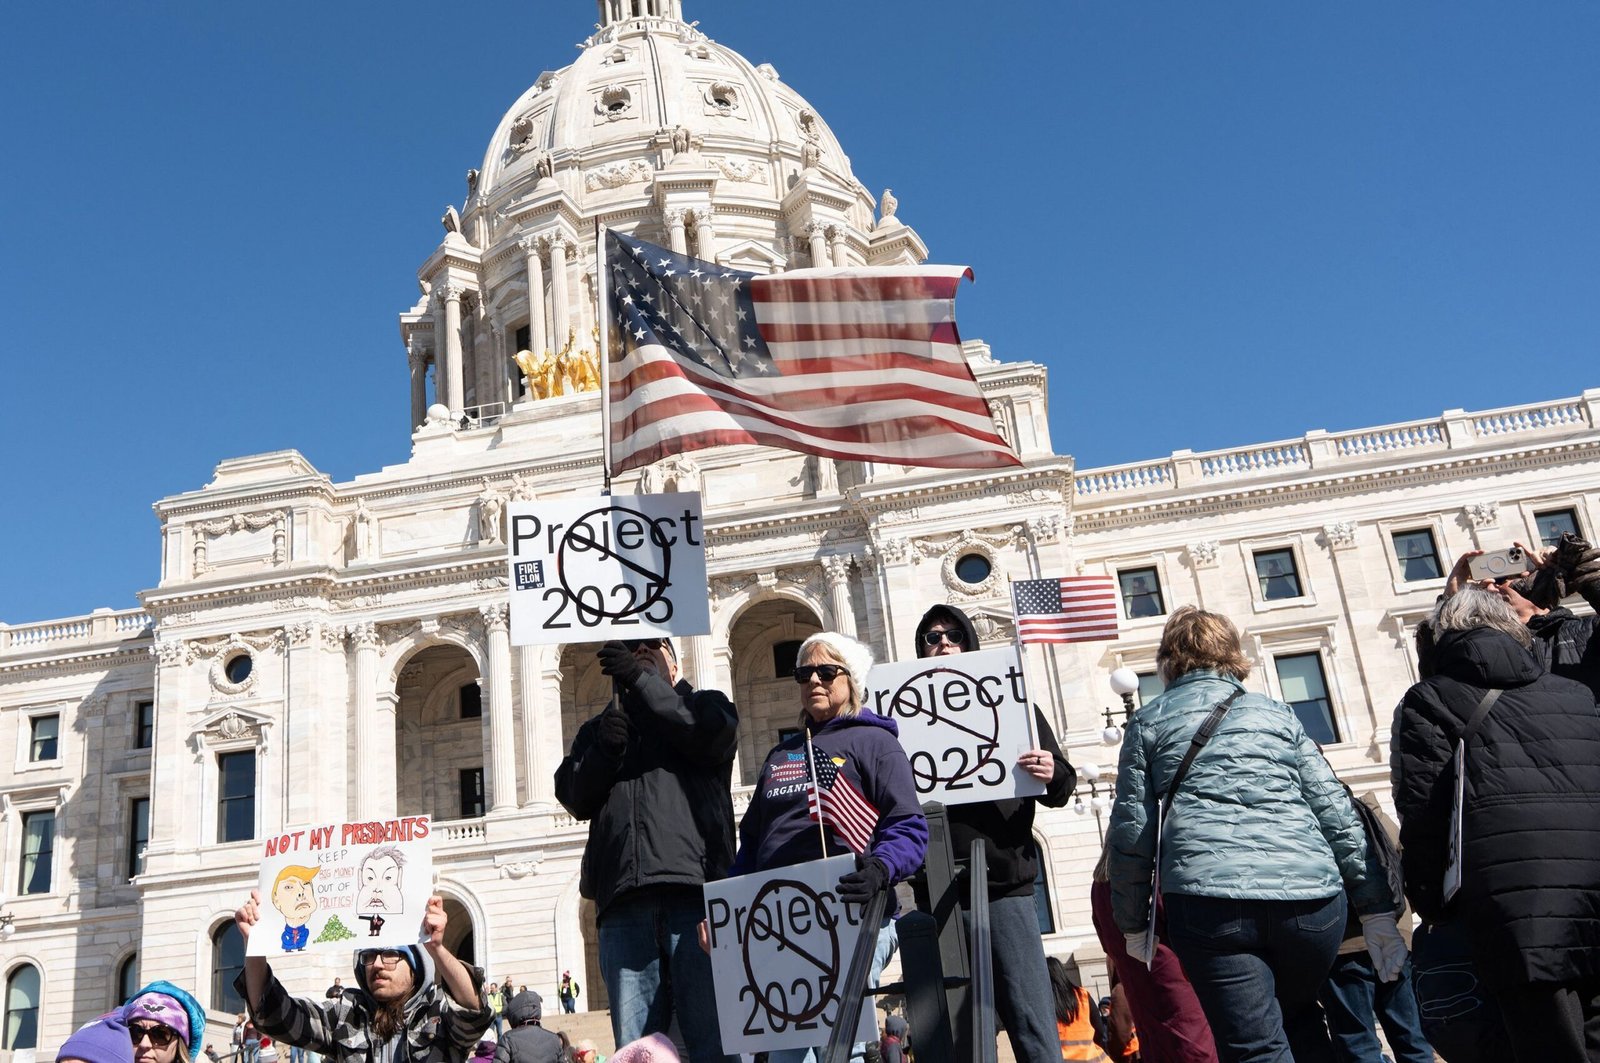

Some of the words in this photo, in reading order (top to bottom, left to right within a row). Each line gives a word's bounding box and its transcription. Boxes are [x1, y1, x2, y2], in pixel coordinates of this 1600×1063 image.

[512, 509, 700, 561] Project
[518, 562, 540, 574] FIRE
[519, 573, 541, 584] ELON
[542, 582, 674, 629] 2025
[910, 743, 1006, 794] 025
[766, 782, 808, 799] ORGANI
[265, 830, 305, 858] NOT
[309, 825, 335, 851] MY
[341, 817, 429, 846] PRESIDENTS
[317, 849, 348, 863] KEEP
[319, 868, 331, 878] BIG
[334, 866, 354, 877] MONEY
[317, 883, 334, 894] OUT
[337, 881, 350, 891] OF
[319, 893, 354, 908] POLITICS!
[739, 976, 841, 1036] 2025
